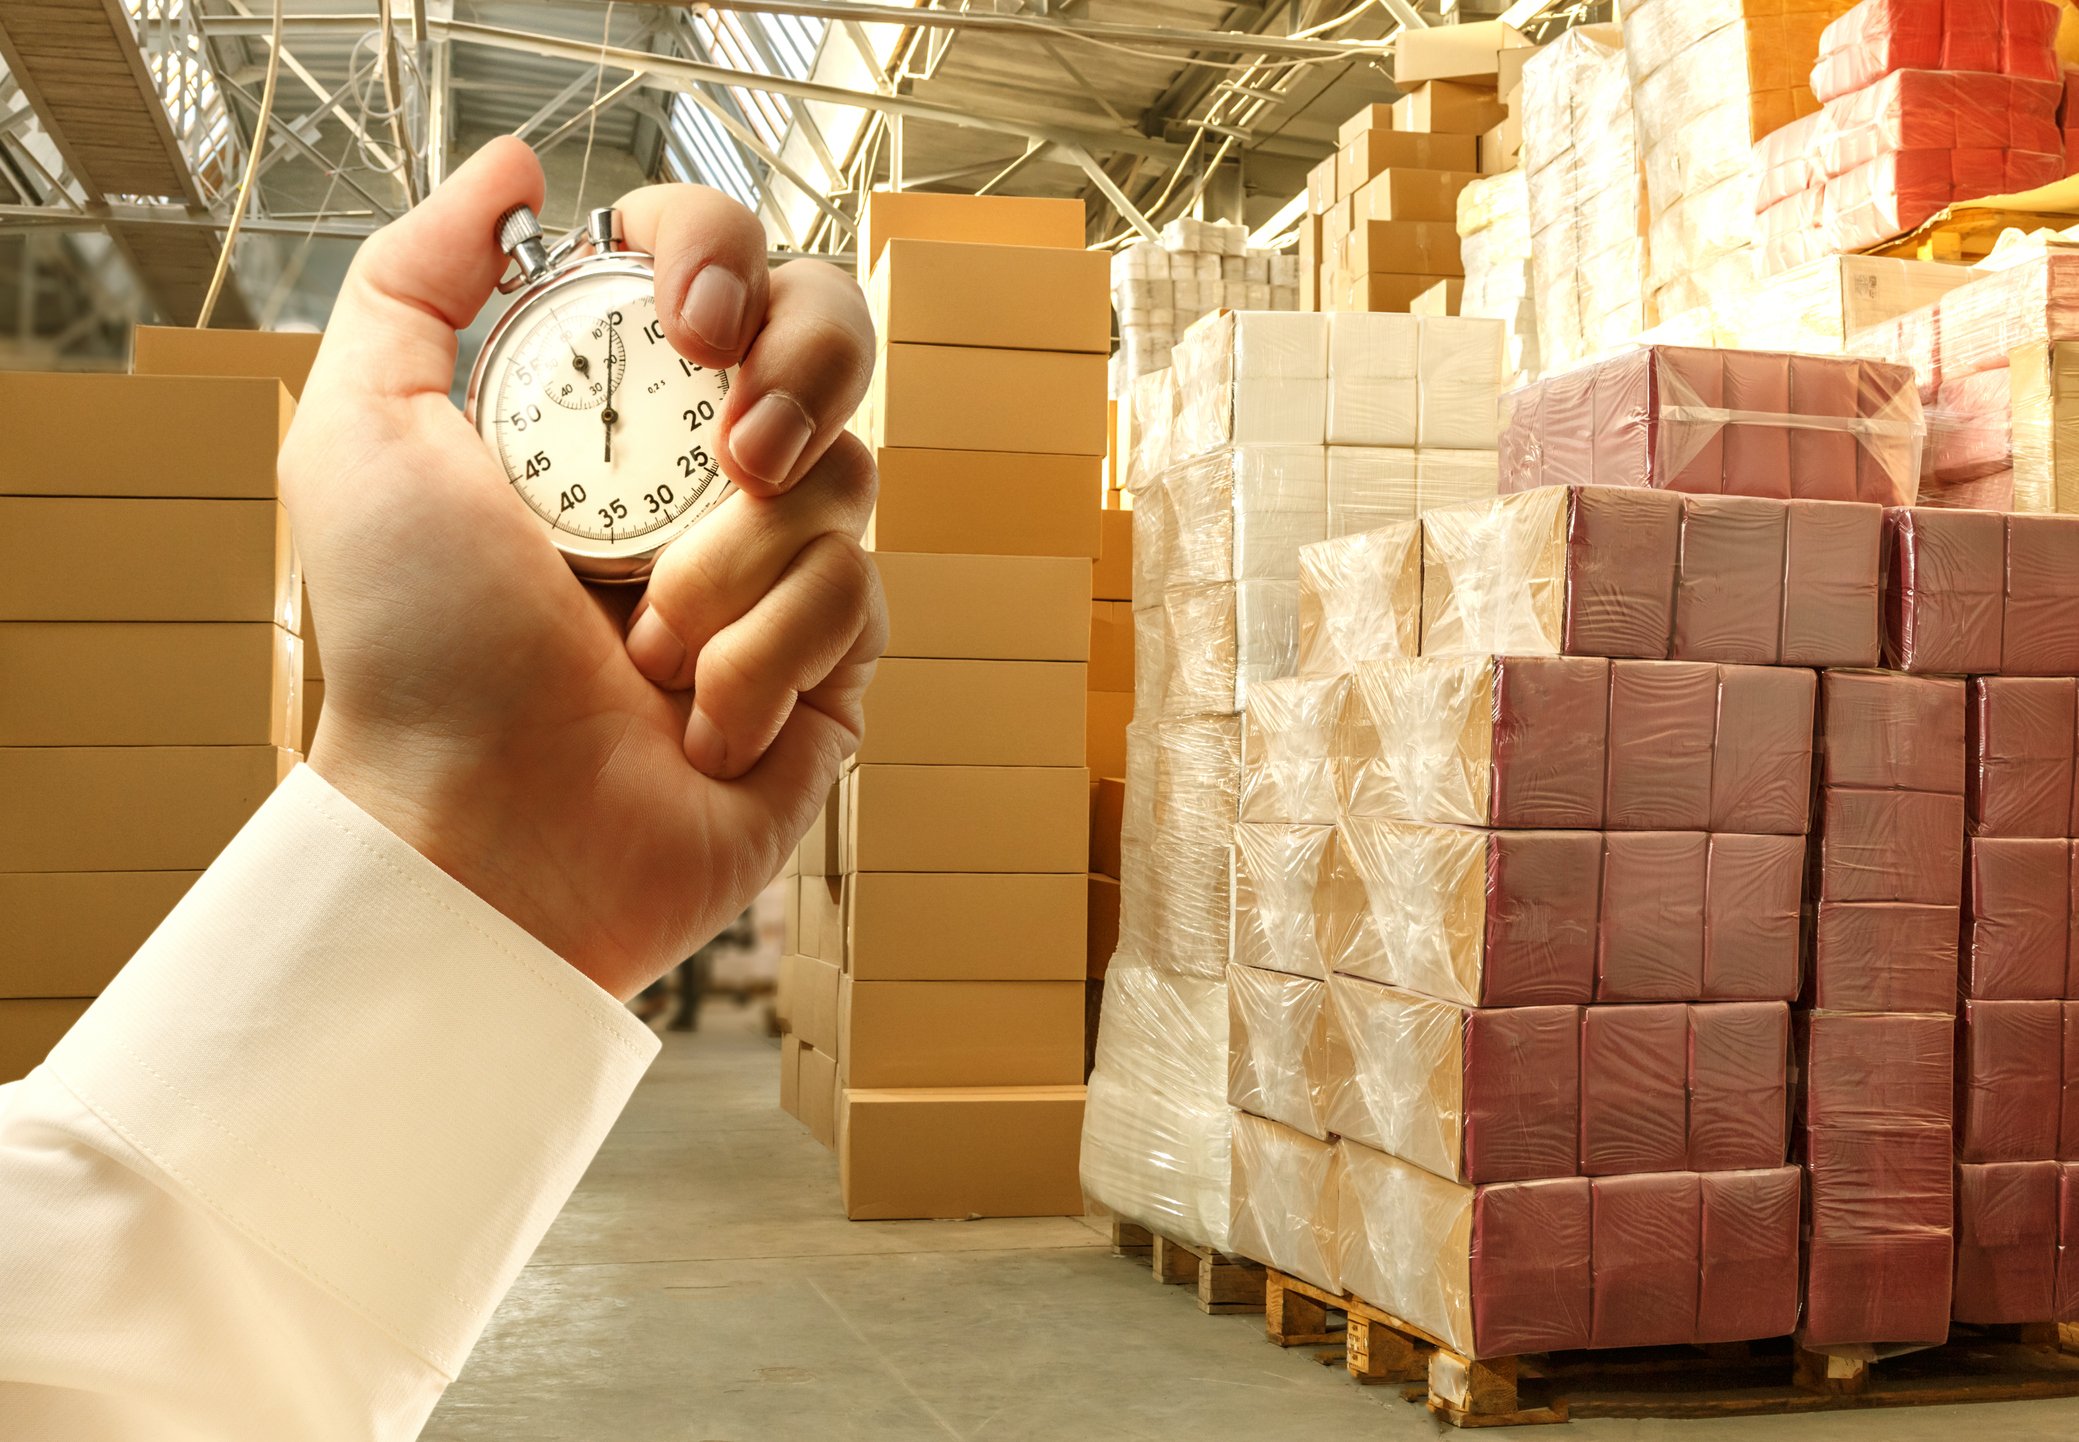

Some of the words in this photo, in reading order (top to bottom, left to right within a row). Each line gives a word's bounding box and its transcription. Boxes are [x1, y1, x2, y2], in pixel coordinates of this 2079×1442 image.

[592, 328, 603, 340] 10
[561, 383, 573, 397] 40
[589, 382, 603, 396] 30
[511, 403, 541, 432] 50
[682, 400, 715, 431] 20
[524, 451, 551, 480] 45
[677, 445, 709, 478] 25
[560, 484, 587, 513] 40
[643, 484, 674, 514] 30
[598, 499, 628, 528] 35
